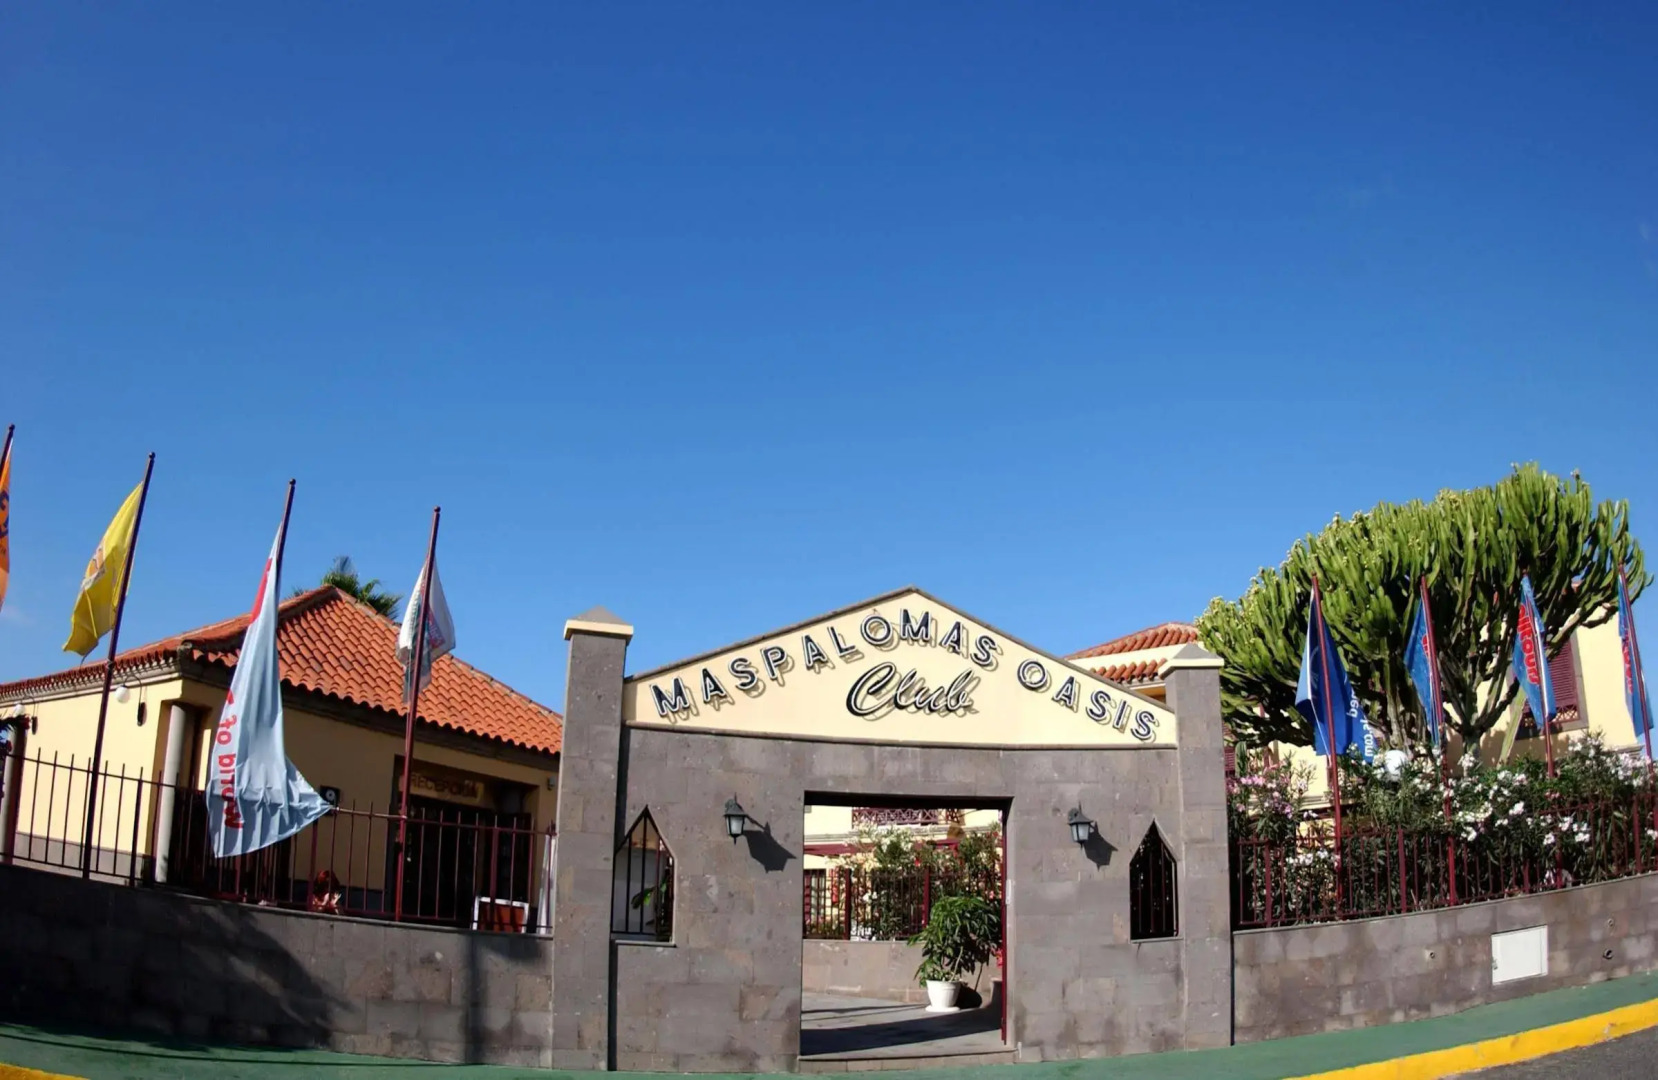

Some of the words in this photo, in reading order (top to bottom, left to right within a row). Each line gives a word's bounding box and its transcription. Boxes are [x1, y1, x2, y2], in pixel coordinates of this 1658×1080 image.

[649, 608, 998, 717] MASPALOMAS
[1017, 649, 1158, 741] OASIS
[846, 661, 974, 717] Club
